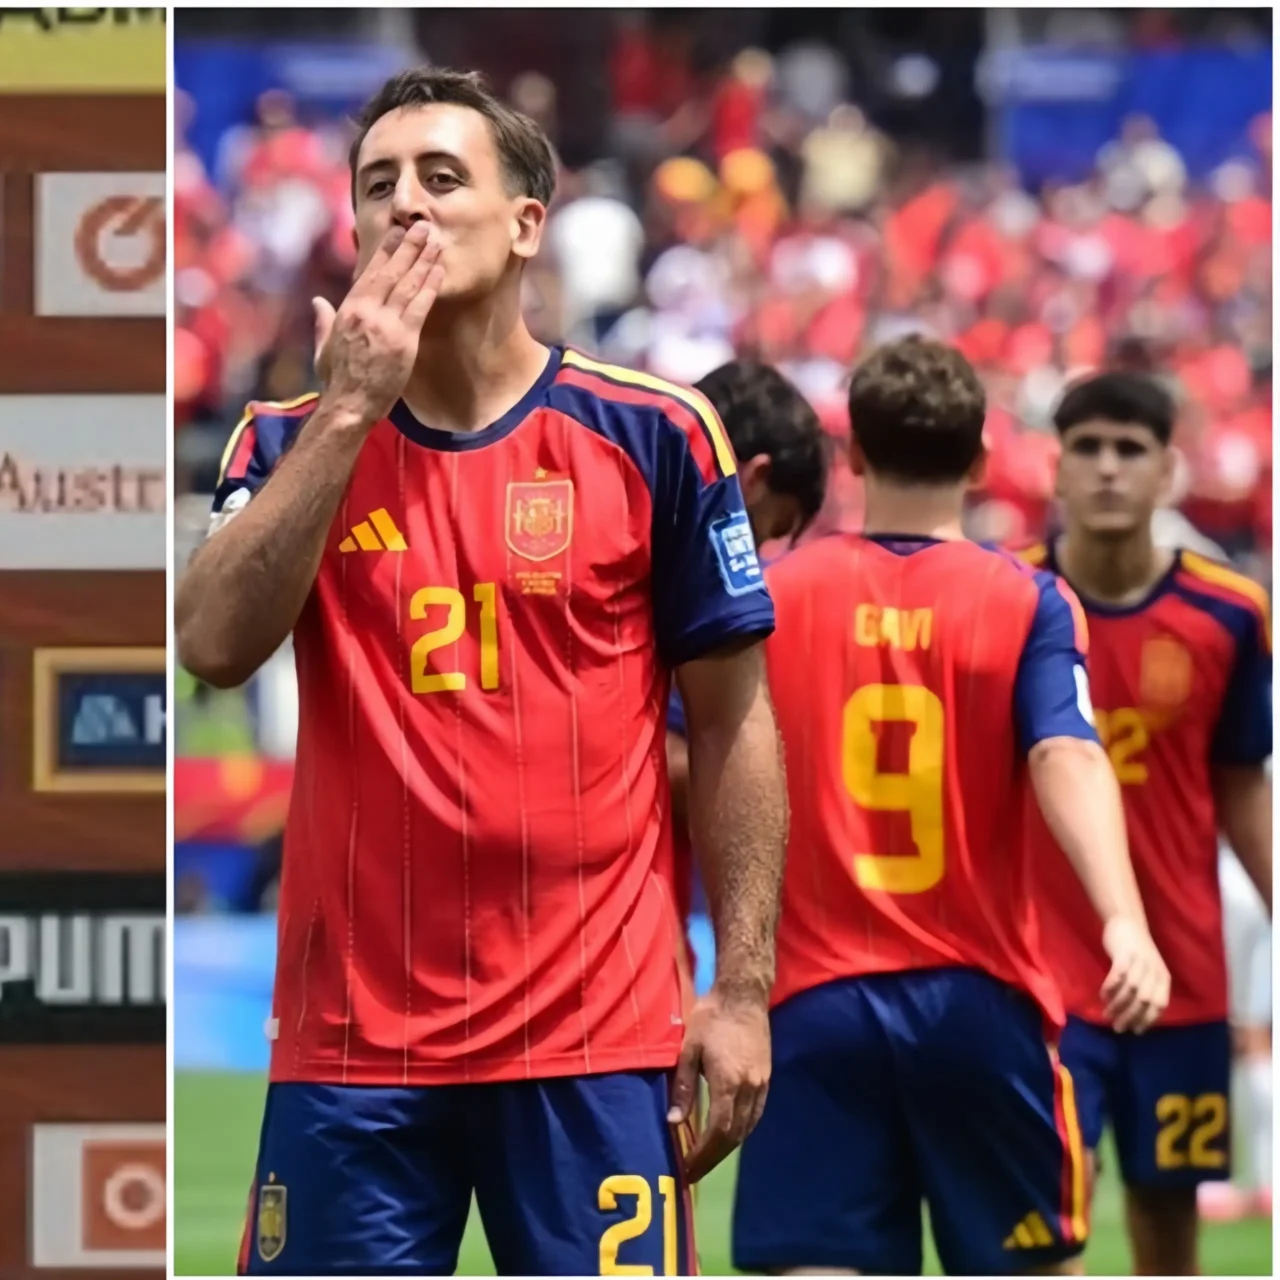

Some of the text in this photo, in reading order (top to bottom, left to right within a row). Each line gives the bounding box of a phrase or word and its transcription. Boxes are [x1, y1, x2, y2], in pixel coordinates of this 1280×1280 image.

[410, 582, 499, 693] 21
[854, 603, 933, 651] GAVI
[841, 683, 946, 894] 9
[1155, 1093, 1228, 1170] 22
[597, 1174, 678, 1277] 21
